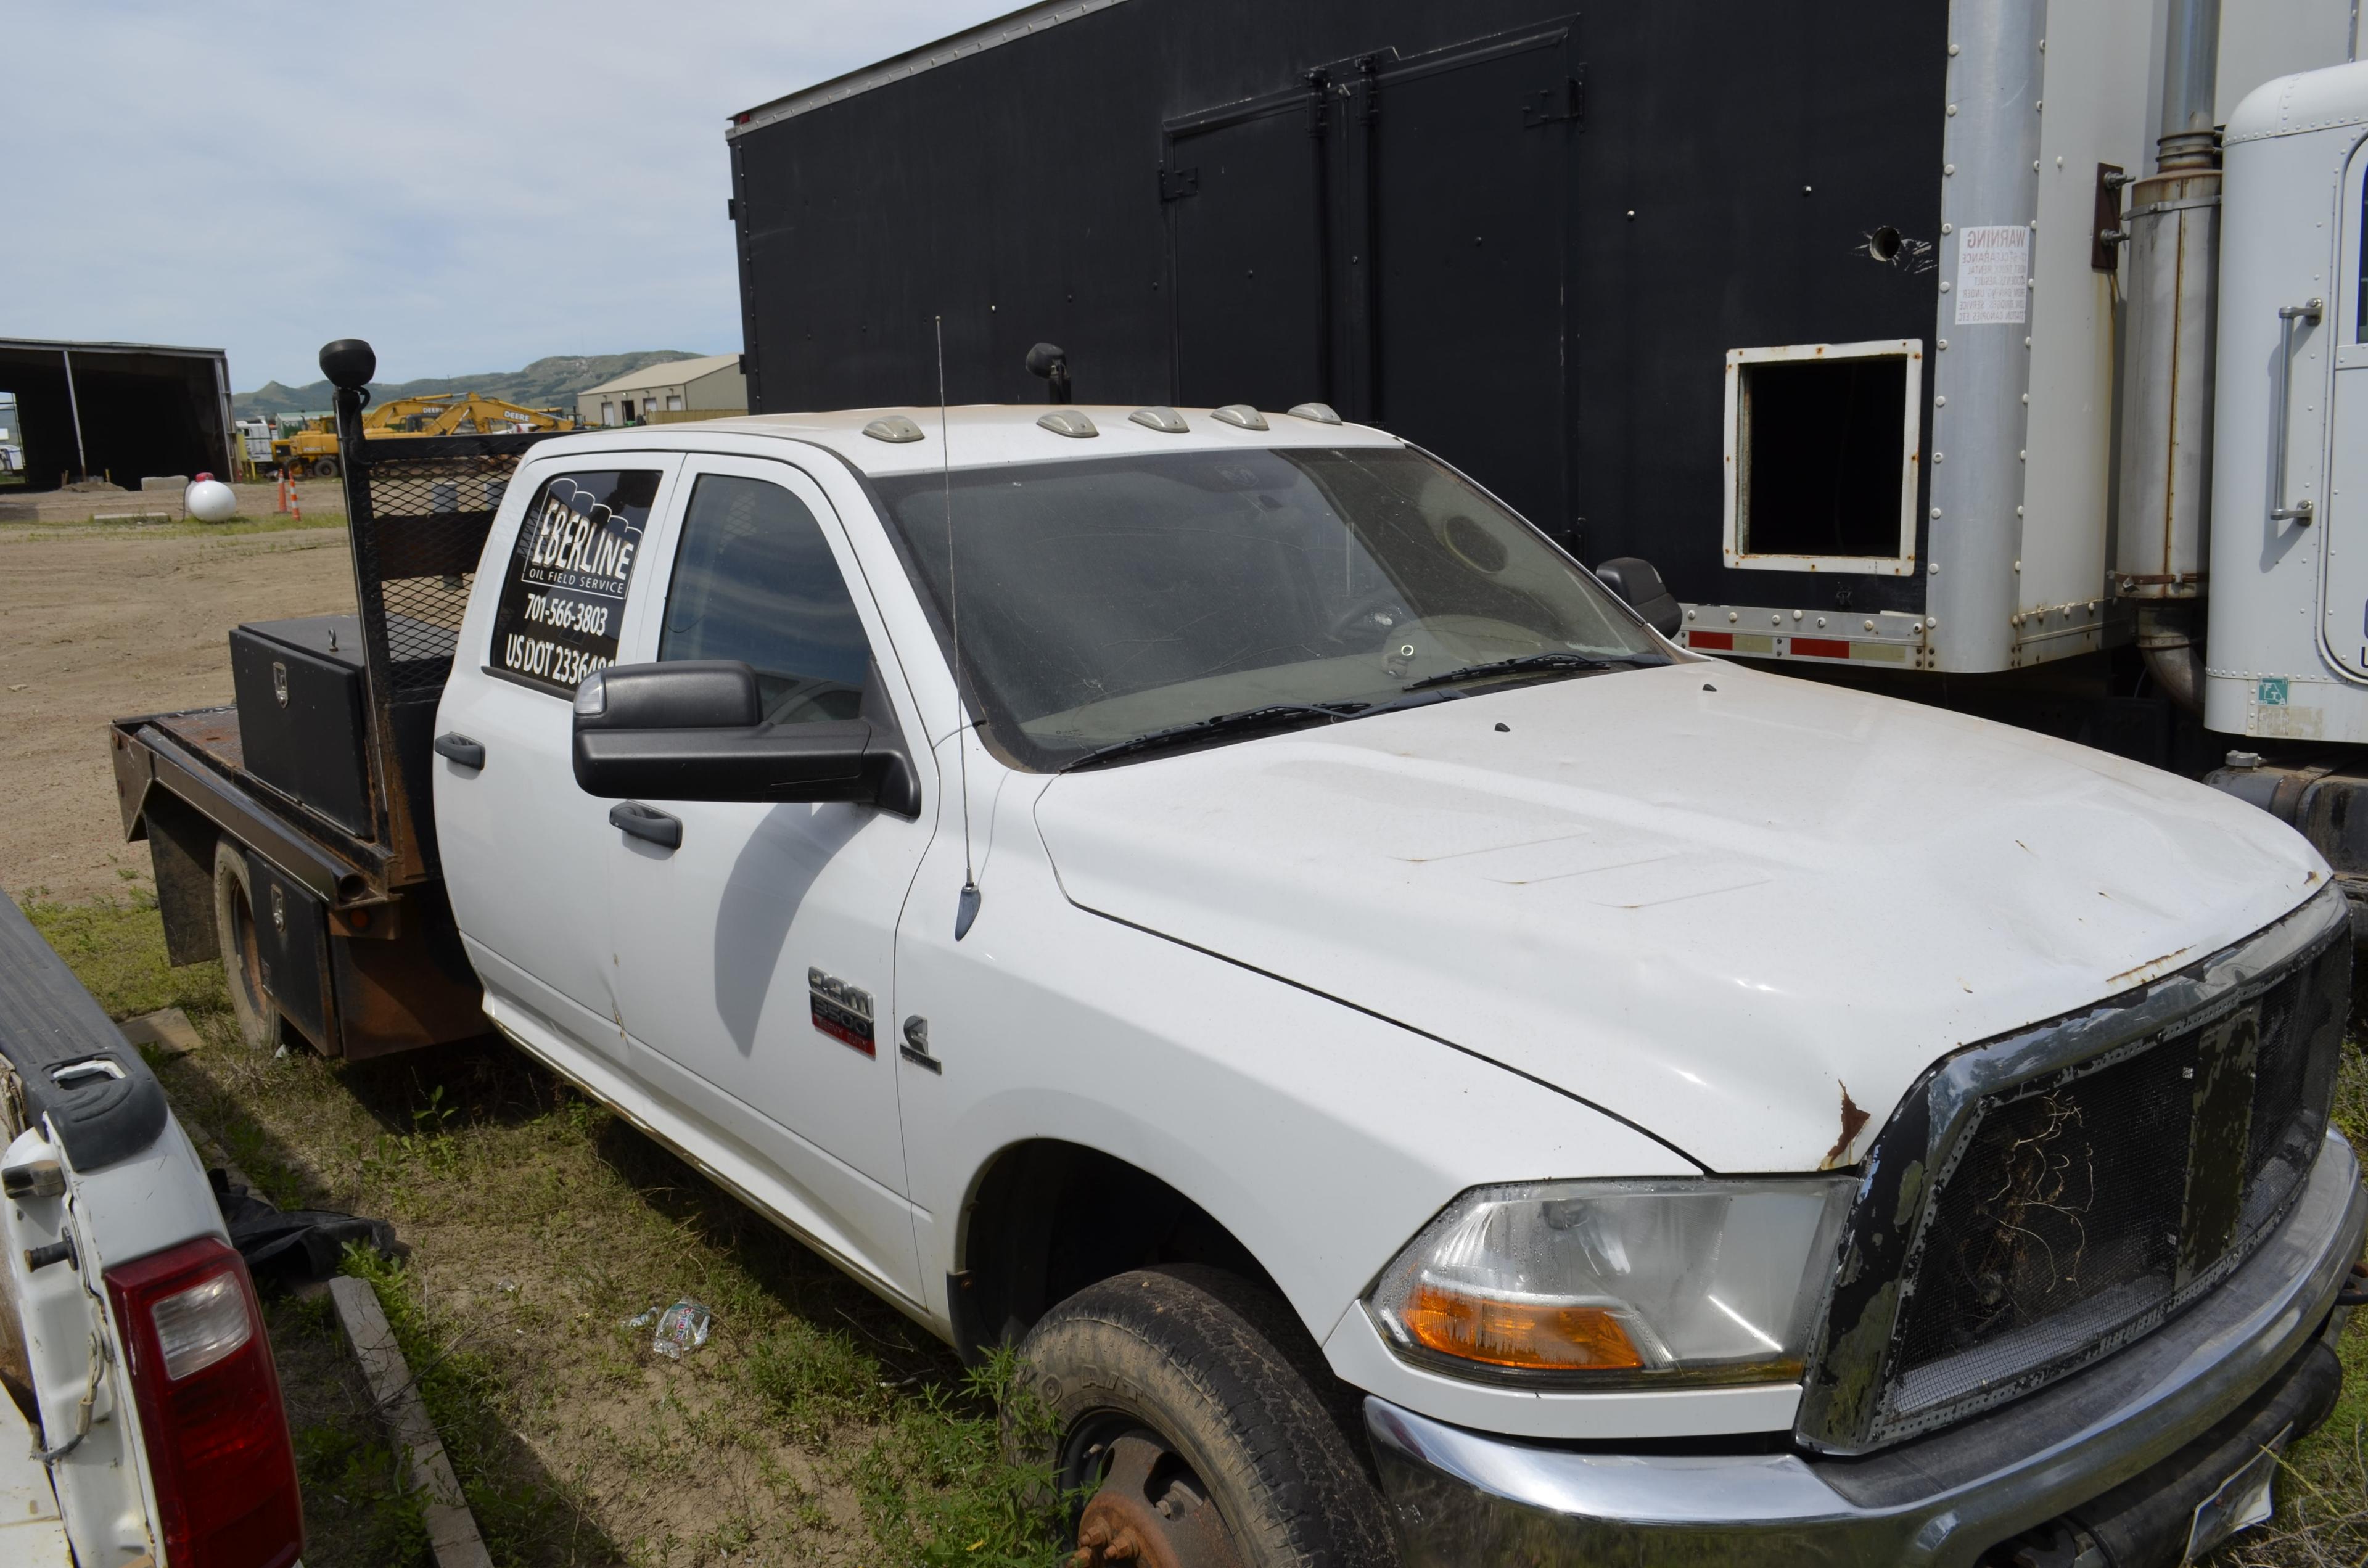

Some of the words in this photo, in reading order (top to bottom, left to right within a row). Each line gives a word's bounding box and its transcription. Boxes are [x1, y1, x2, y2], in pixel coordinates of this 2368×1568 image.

[504, 411, 530, 422] DEERE
[532, 499, 634, 580] EBERLINE
[529, 569, 544, 580] OIL
[548, 572, 576, 585] FIELD
[579, 577, 624, 594] SERVICE
[524, 593, 608, 636] 701-566-3803
[506, 633, 524, 667] US
[524, 638, 554, 676] DOT
[552, 642, 616, 685] 23364
[808, 966, 874, 1020] RAM
[814, 997, 868, 1036] 3500
[1082, 1364, 1143, 1402] A/T
